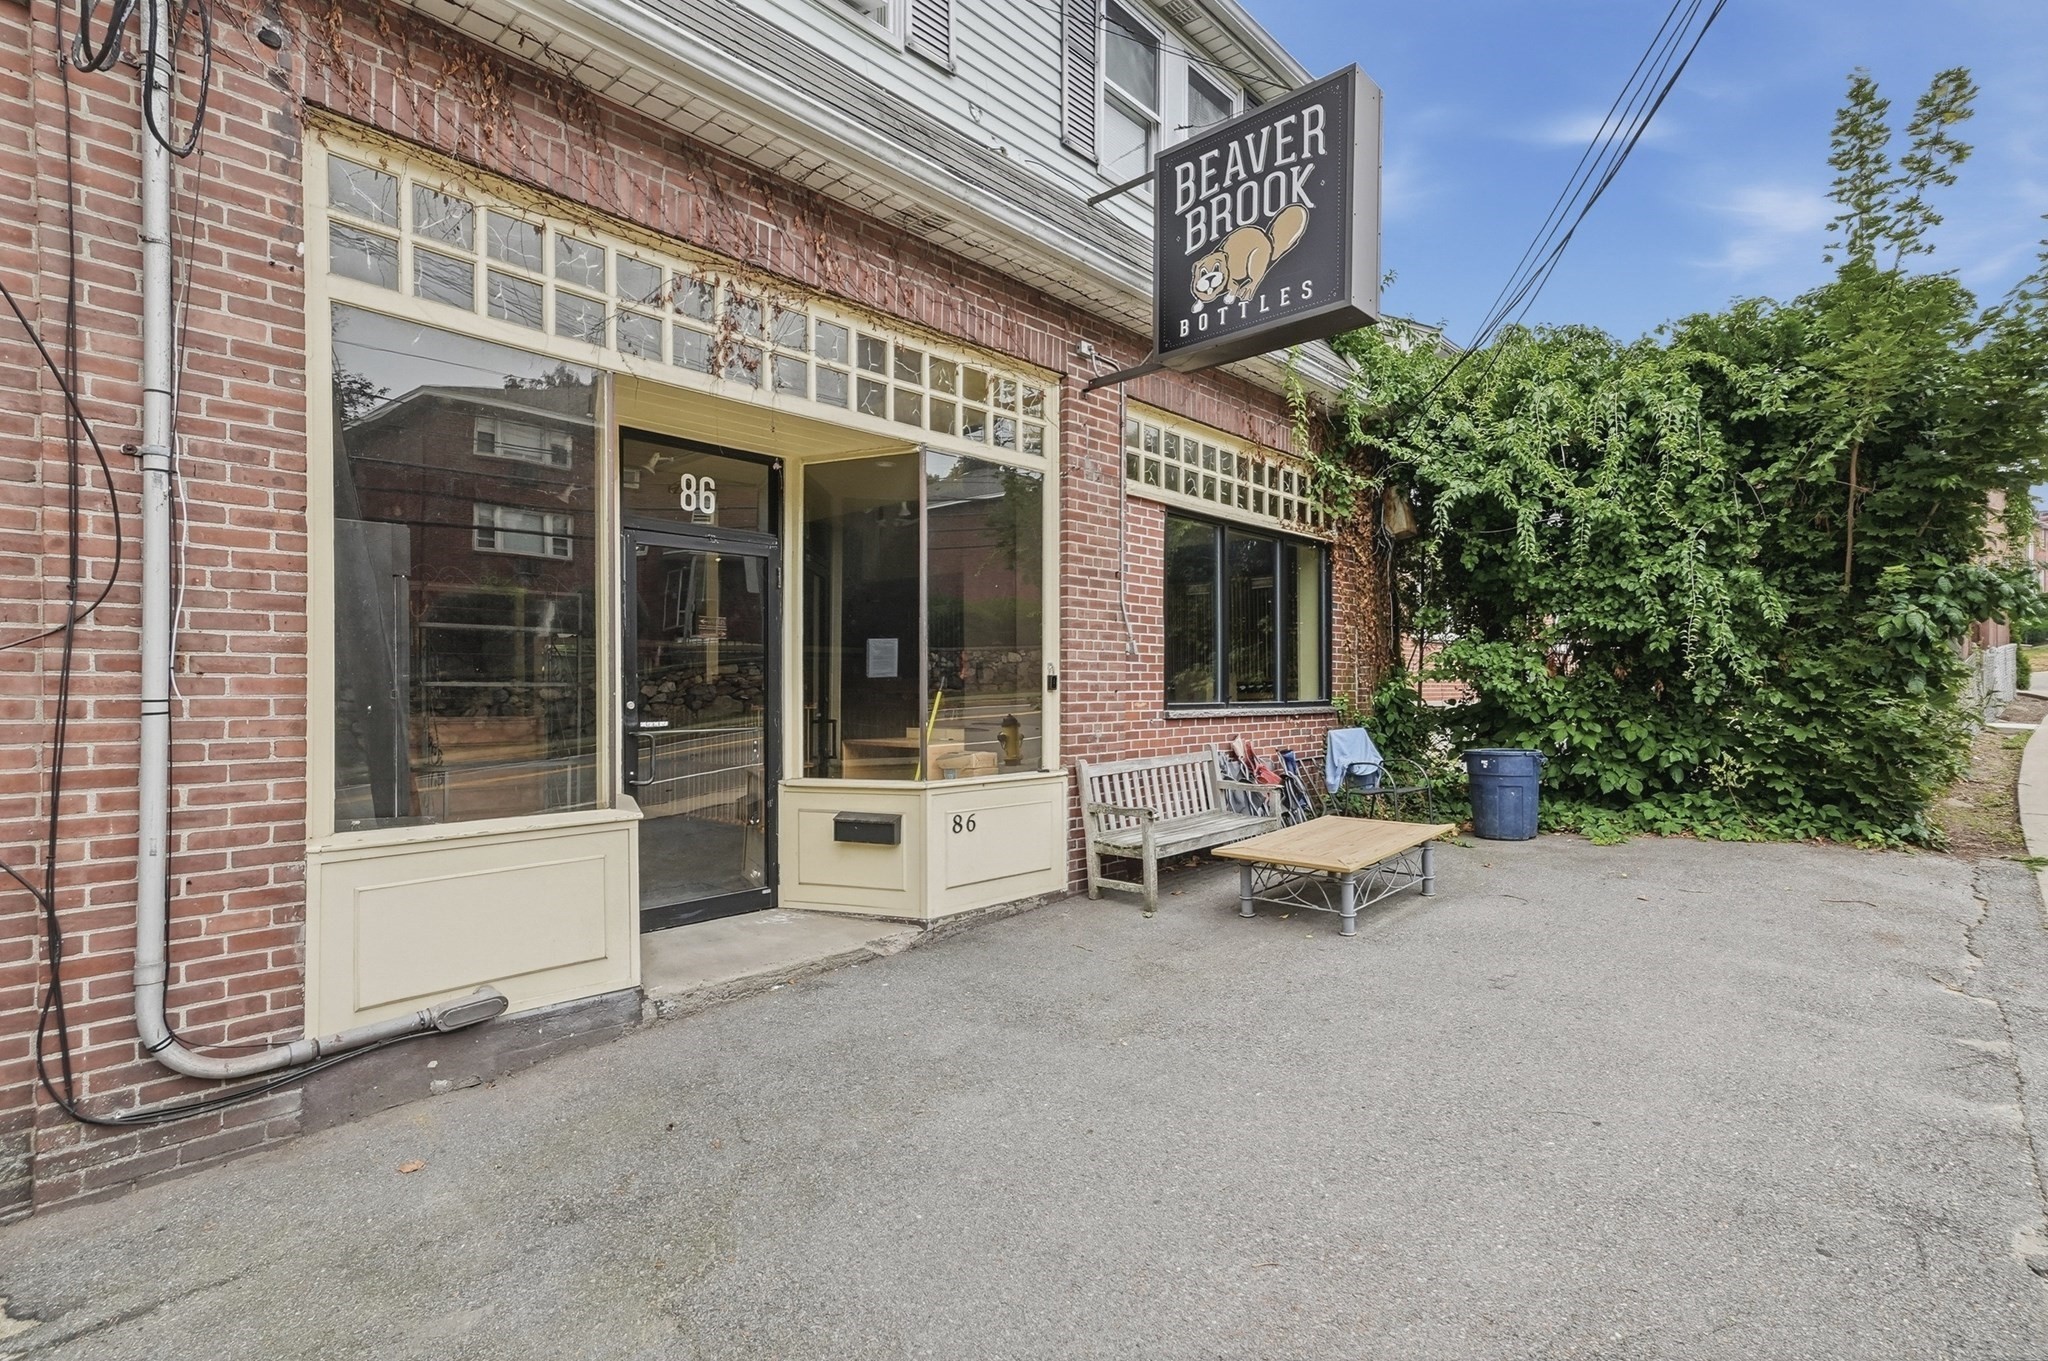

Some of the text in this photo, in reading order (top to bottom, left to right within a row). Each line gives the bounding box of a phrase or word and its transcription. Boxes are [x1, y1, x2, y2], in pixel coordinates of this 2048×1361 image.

[1175, 104, 1327, 215] BEAVER
[1185, 163, 1316, 255] BROOK
[1179, 280, 1313, 337] BOTTLES
[680, 473, 716, 514] 86
[952, 813, 976, 834] 86
